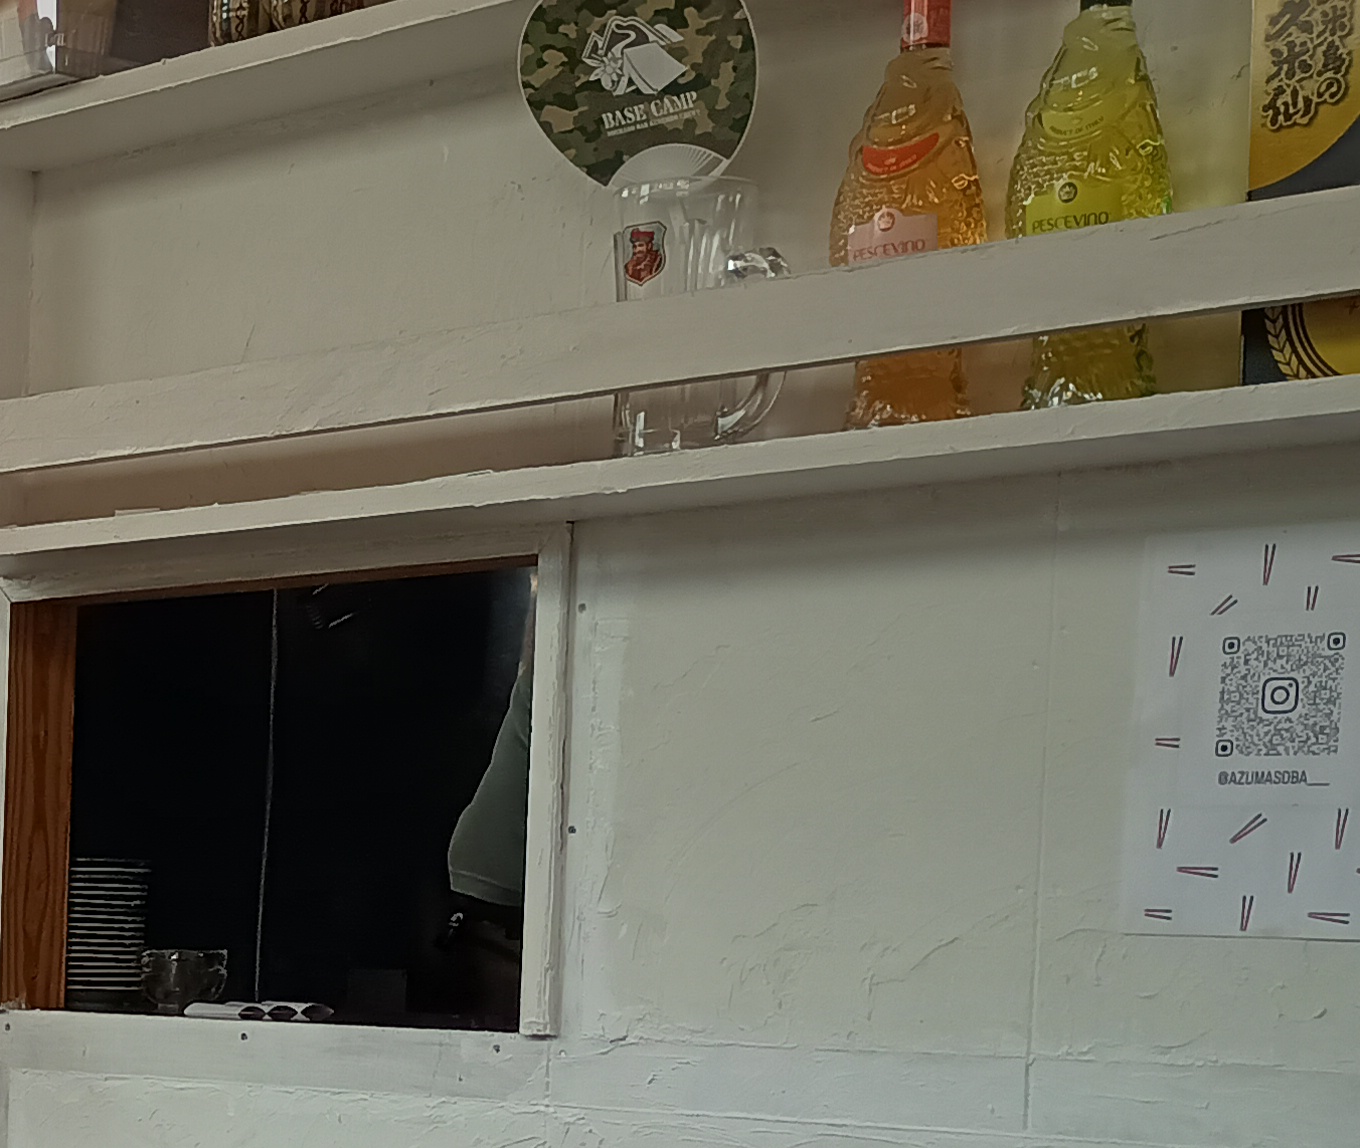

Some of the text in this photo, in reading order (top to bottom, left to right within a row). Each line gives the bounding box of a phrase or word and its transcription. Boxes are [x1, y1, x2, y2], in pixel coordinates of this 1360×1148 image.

[1316, 0, 1350, 101] 米島の
[601, 103, 647, 130] BASE
[650, 91, 698, 118] CAMP
[1031, 210, 1109, 232] PESCEVINO
[852, 238, 926, 261] PESCEVINO
